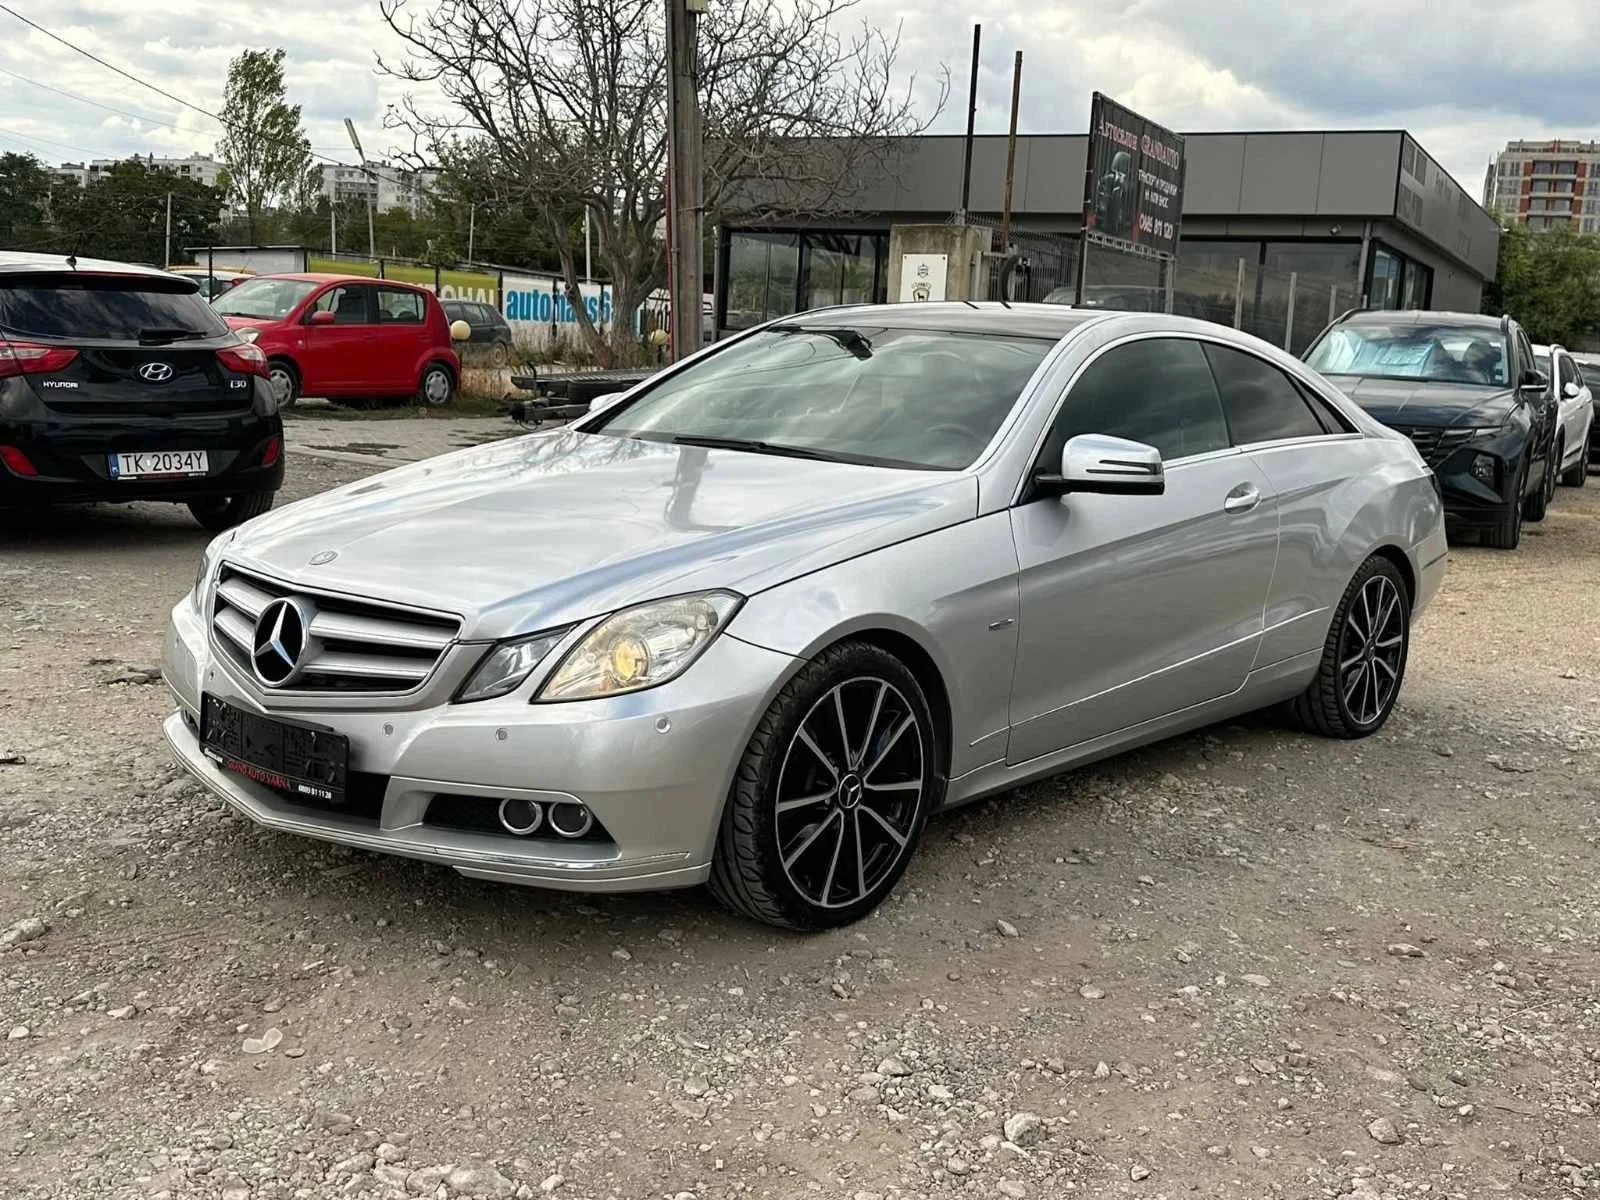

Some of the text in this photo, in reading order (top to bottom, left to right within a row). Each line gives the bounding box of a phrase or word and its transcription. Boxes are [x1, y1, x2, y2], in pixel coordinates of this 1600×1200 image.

[43, 380, 79, 389] HYUNDAI
[122, 452, 203, 473] TK 2034Y
